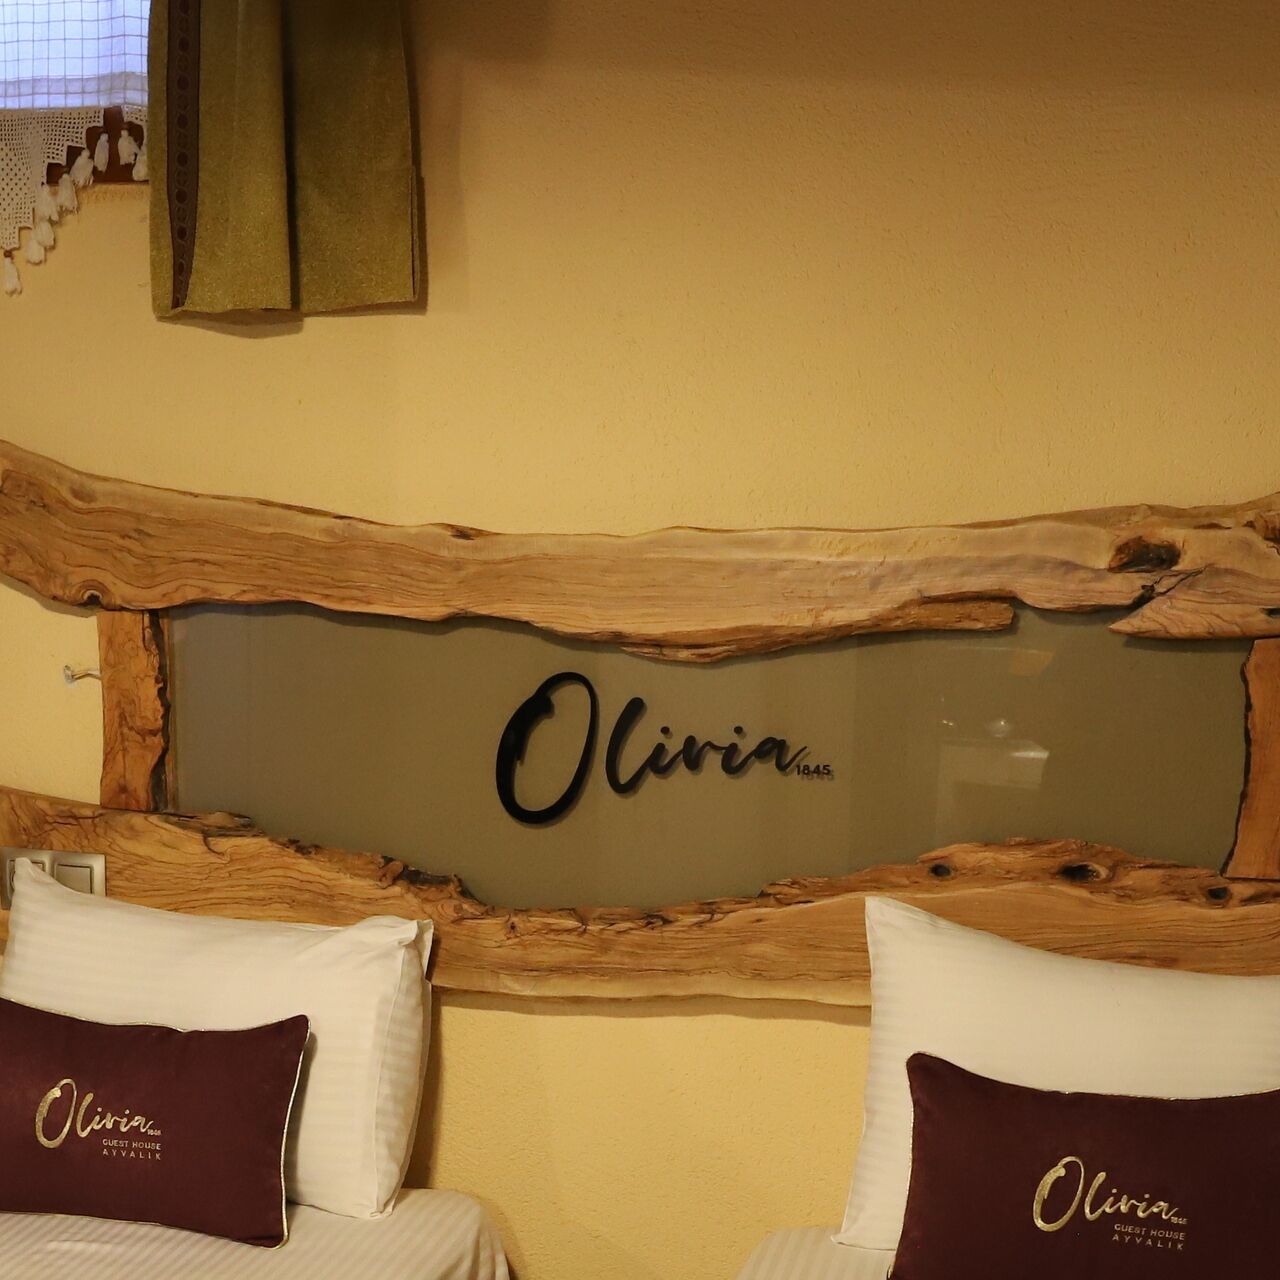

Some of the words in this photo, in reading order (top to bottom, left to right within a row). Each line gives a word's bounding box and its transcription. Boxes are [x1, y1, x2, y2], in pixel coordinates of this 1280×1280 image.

[495, 671, 807, 824] Olivia
[795, 764, 832, 777] 1845
[35, 1078, 154, 1149] Olivia
[102, 1138, 129, 1148] GUEST
[132, 1141, 162, 1151] HOUSE
[102, 1148, 161, 1161] AYVALIK
[1033, 1155, 1179, 1233] Olivia
[1114, 1223, 1146, 1236] GUEST
[1150, 1228, 1186, 1241] HOUSE
[1112, 1234, 1184, 1250] AYVALIK
